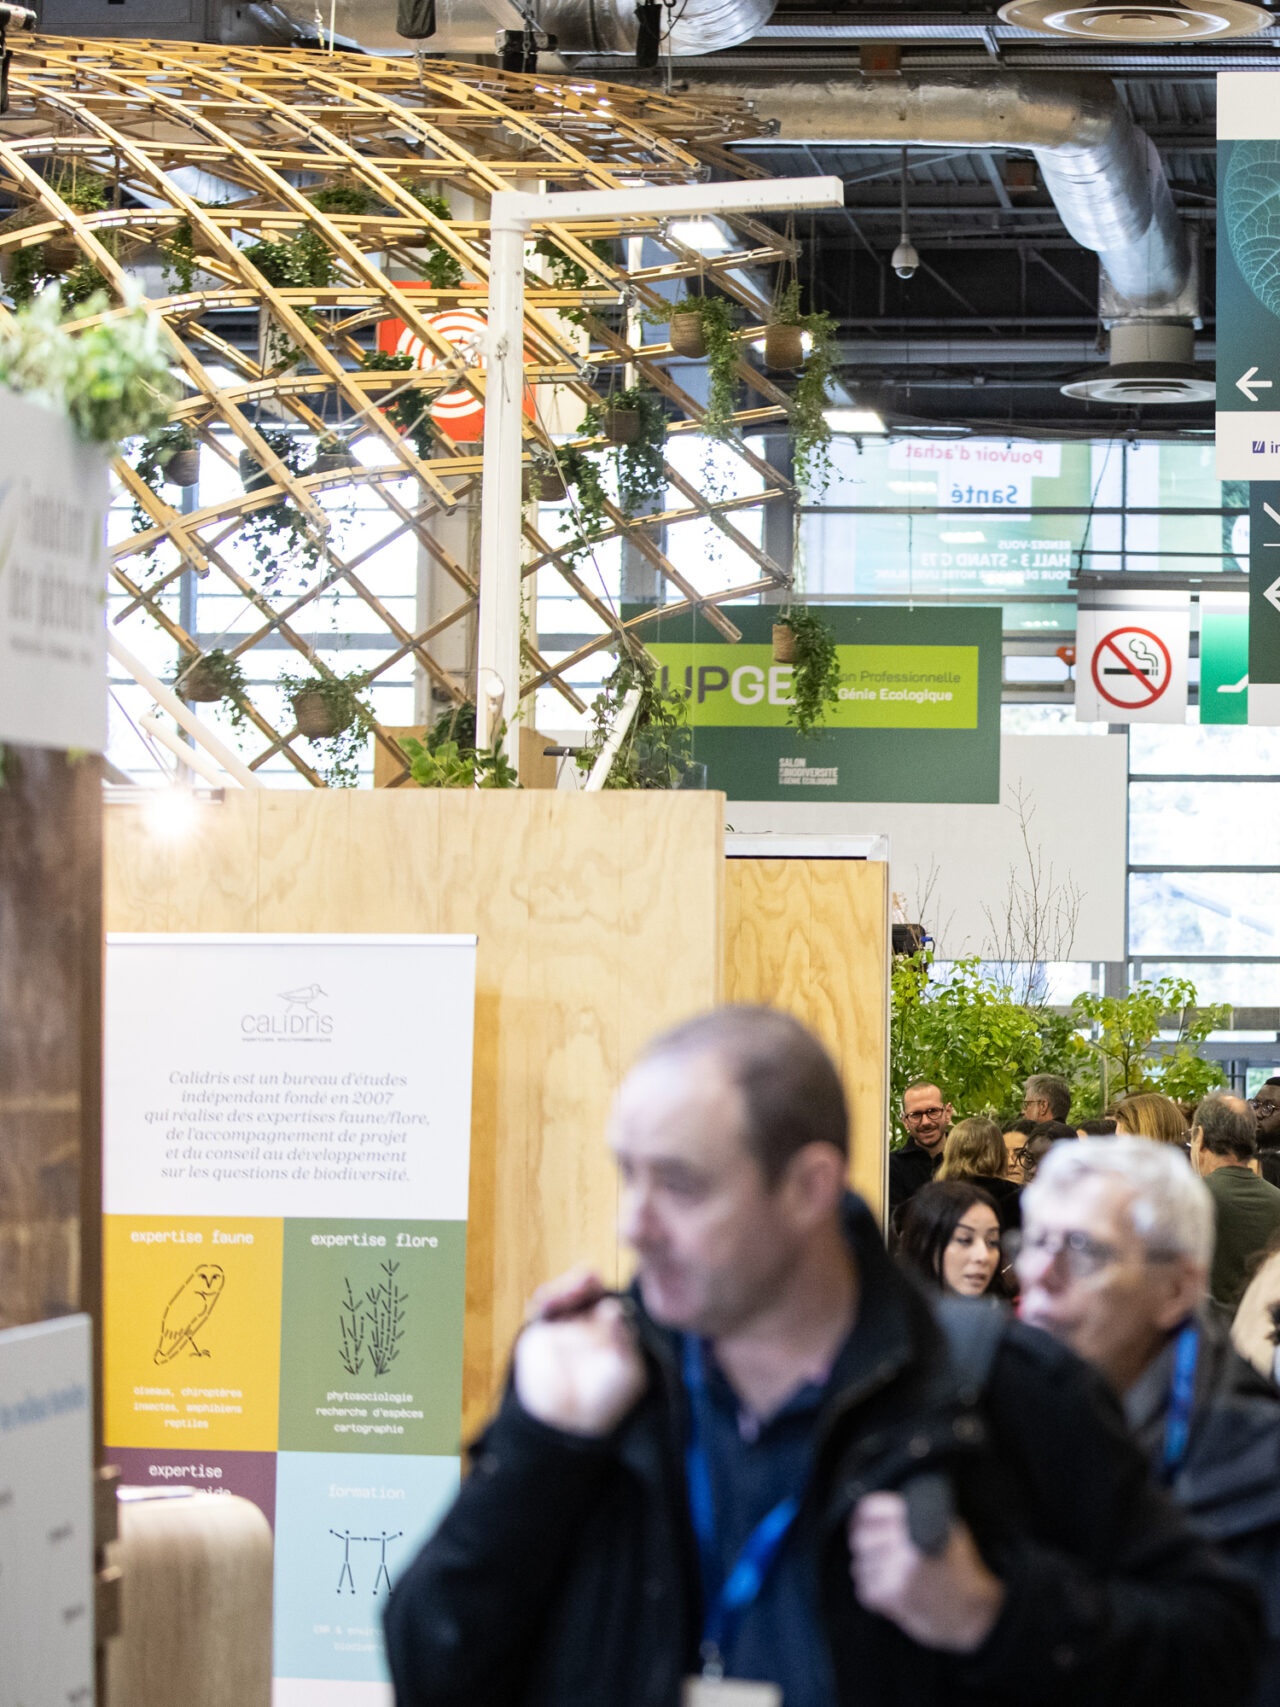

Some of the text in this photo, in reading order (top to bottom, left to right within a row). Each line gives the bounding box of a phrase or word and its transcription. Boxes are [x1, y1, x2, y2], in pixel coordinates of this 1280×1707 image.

[661, 665, 797, 705] UPGE
[860, 670, 961, 684] Professionnelle
[837, 687, 953, 703] Génie Ecologique
[169, 1070, 408, 1087] Calidris est un bureau d'études
[182, 1089, 395, 1107] indépendant fondé en 2007
[144, 1108, 169, 1125] qui
[172, 1108, 223, 1122] réalise
[227, 1108, 254, 1122] des
[256, 1110, 336, 1126] expertises
[166, 1127, 408, 1147] de l'accompagnement de projet
[165, 1145, 408, 1165] et du conseil au développement
[160, 1164, 411, 1182] sur les questions de biodiversité.
[130, 1230, 254, 1246] expertise faune
[311, 1232, 438, 1249] expertise flore
[326, 1391, 413, 1404] phytosociologie
[316, 1407, 424, 1419] recherche d'espèces
[164, 1418, 209, 1429] reptiles
[334, 1423, 404, 1435] cartographie
[148, 1463, 223, 1479] expertise
[328, 1484, 406, 1499] formation
